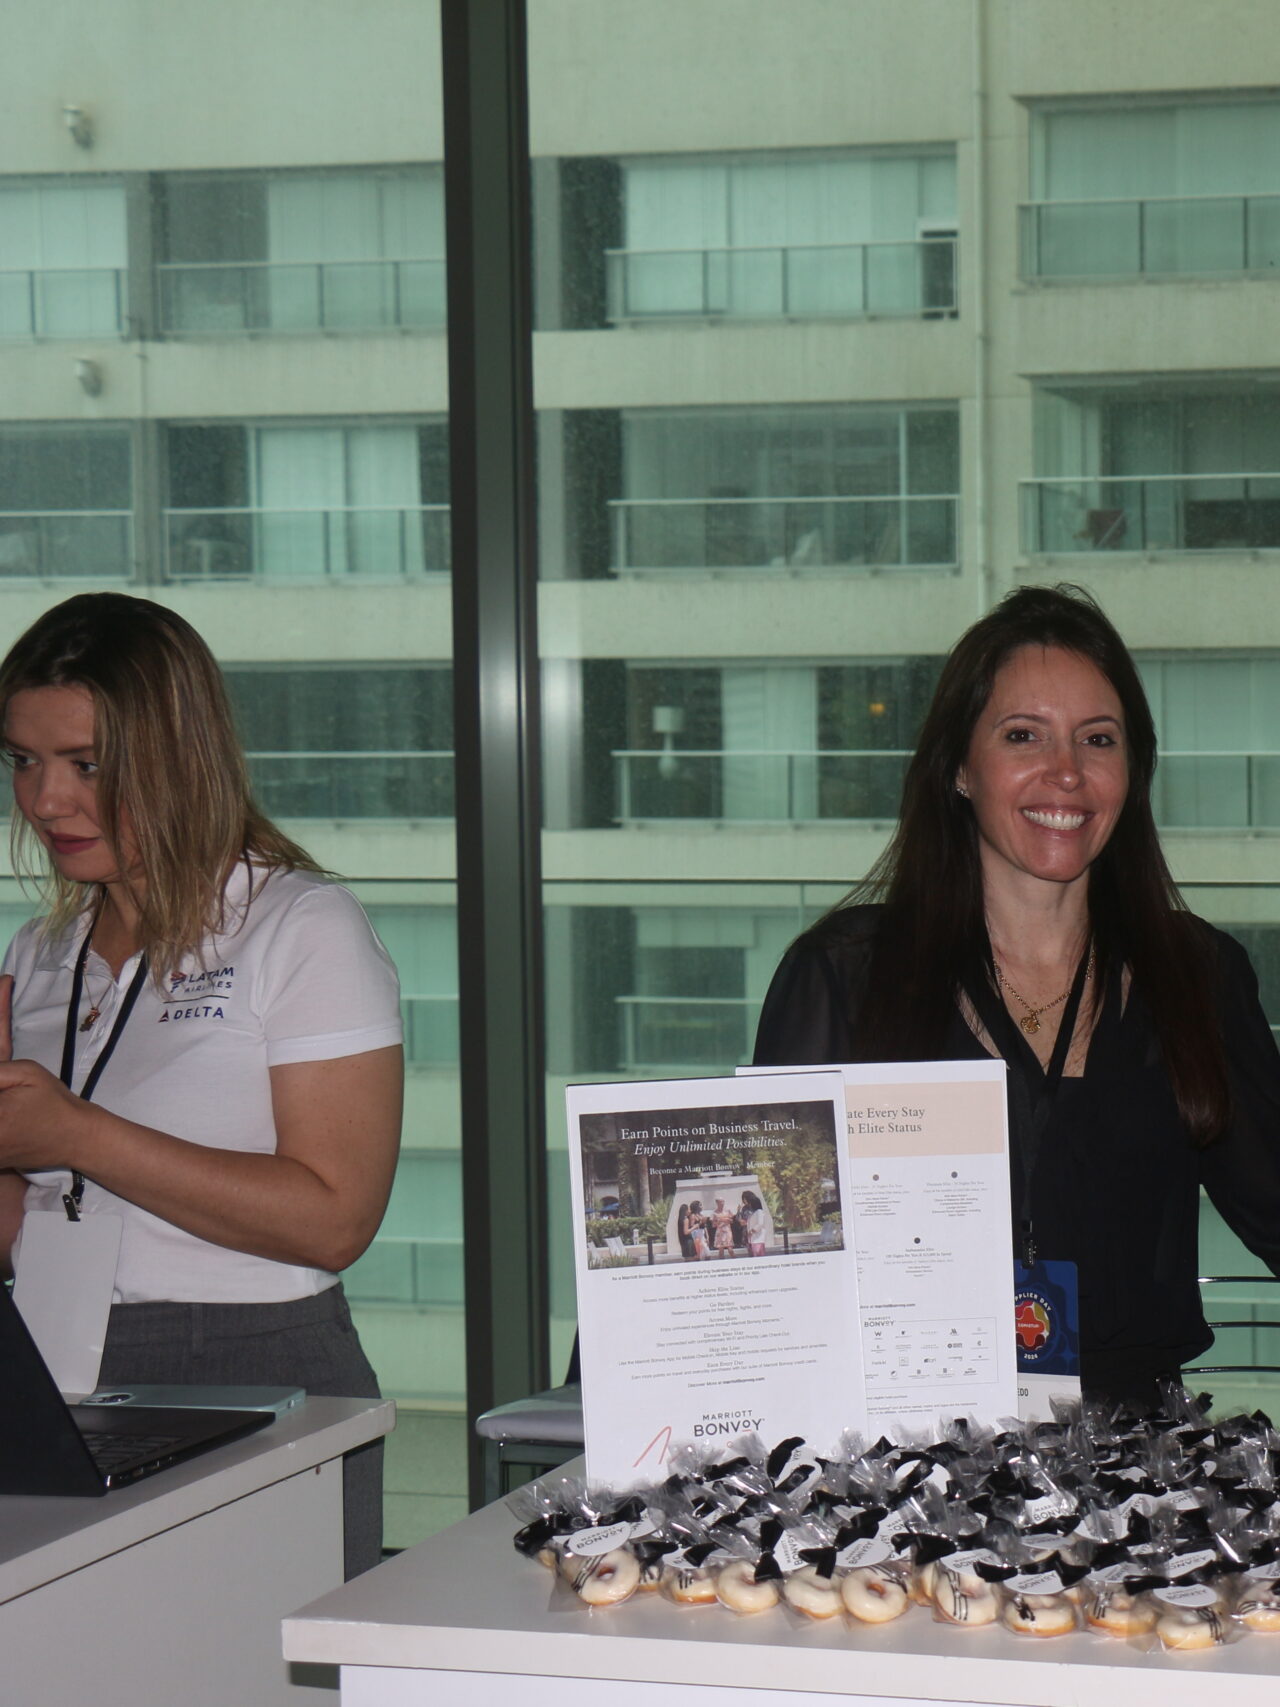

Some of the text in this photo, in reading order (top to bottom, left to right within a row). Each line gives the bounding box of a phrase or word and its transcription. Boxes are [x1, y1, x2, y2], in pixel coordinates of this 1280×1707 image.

[188, 967, 234, 983] LATAM
[174, 1007, 224, 1020] DELTA
[867, 1108, 898, 1120] Every
[901, 1106, 925, 1119] Stay
[621, 1128, 649, 1140] Earn
[653, 1125, 689, 1138] Points
[692, 1127, 706, 1136] on
[709, 1122, 758, 1135] Business
[858, 1123, 885, 1134] Elite
[887, 1122, 922, 1133] Status
[634, 1135, 787, 1157] Enjoy Unlimited Possibilities.
[649, 1166, 677, 1175] Become
[684, 1163, 714, 1173] Marriott
[746, 1160, 775, 1169] Member
[1014, 1292, 1052, 1311] PPLIER DAY
[702, 1410, 753, 1421] MARRIOTT
[694, 1419, 762, 1437] BONVOY
[577, 1526, 625, 1549] BONVOY
